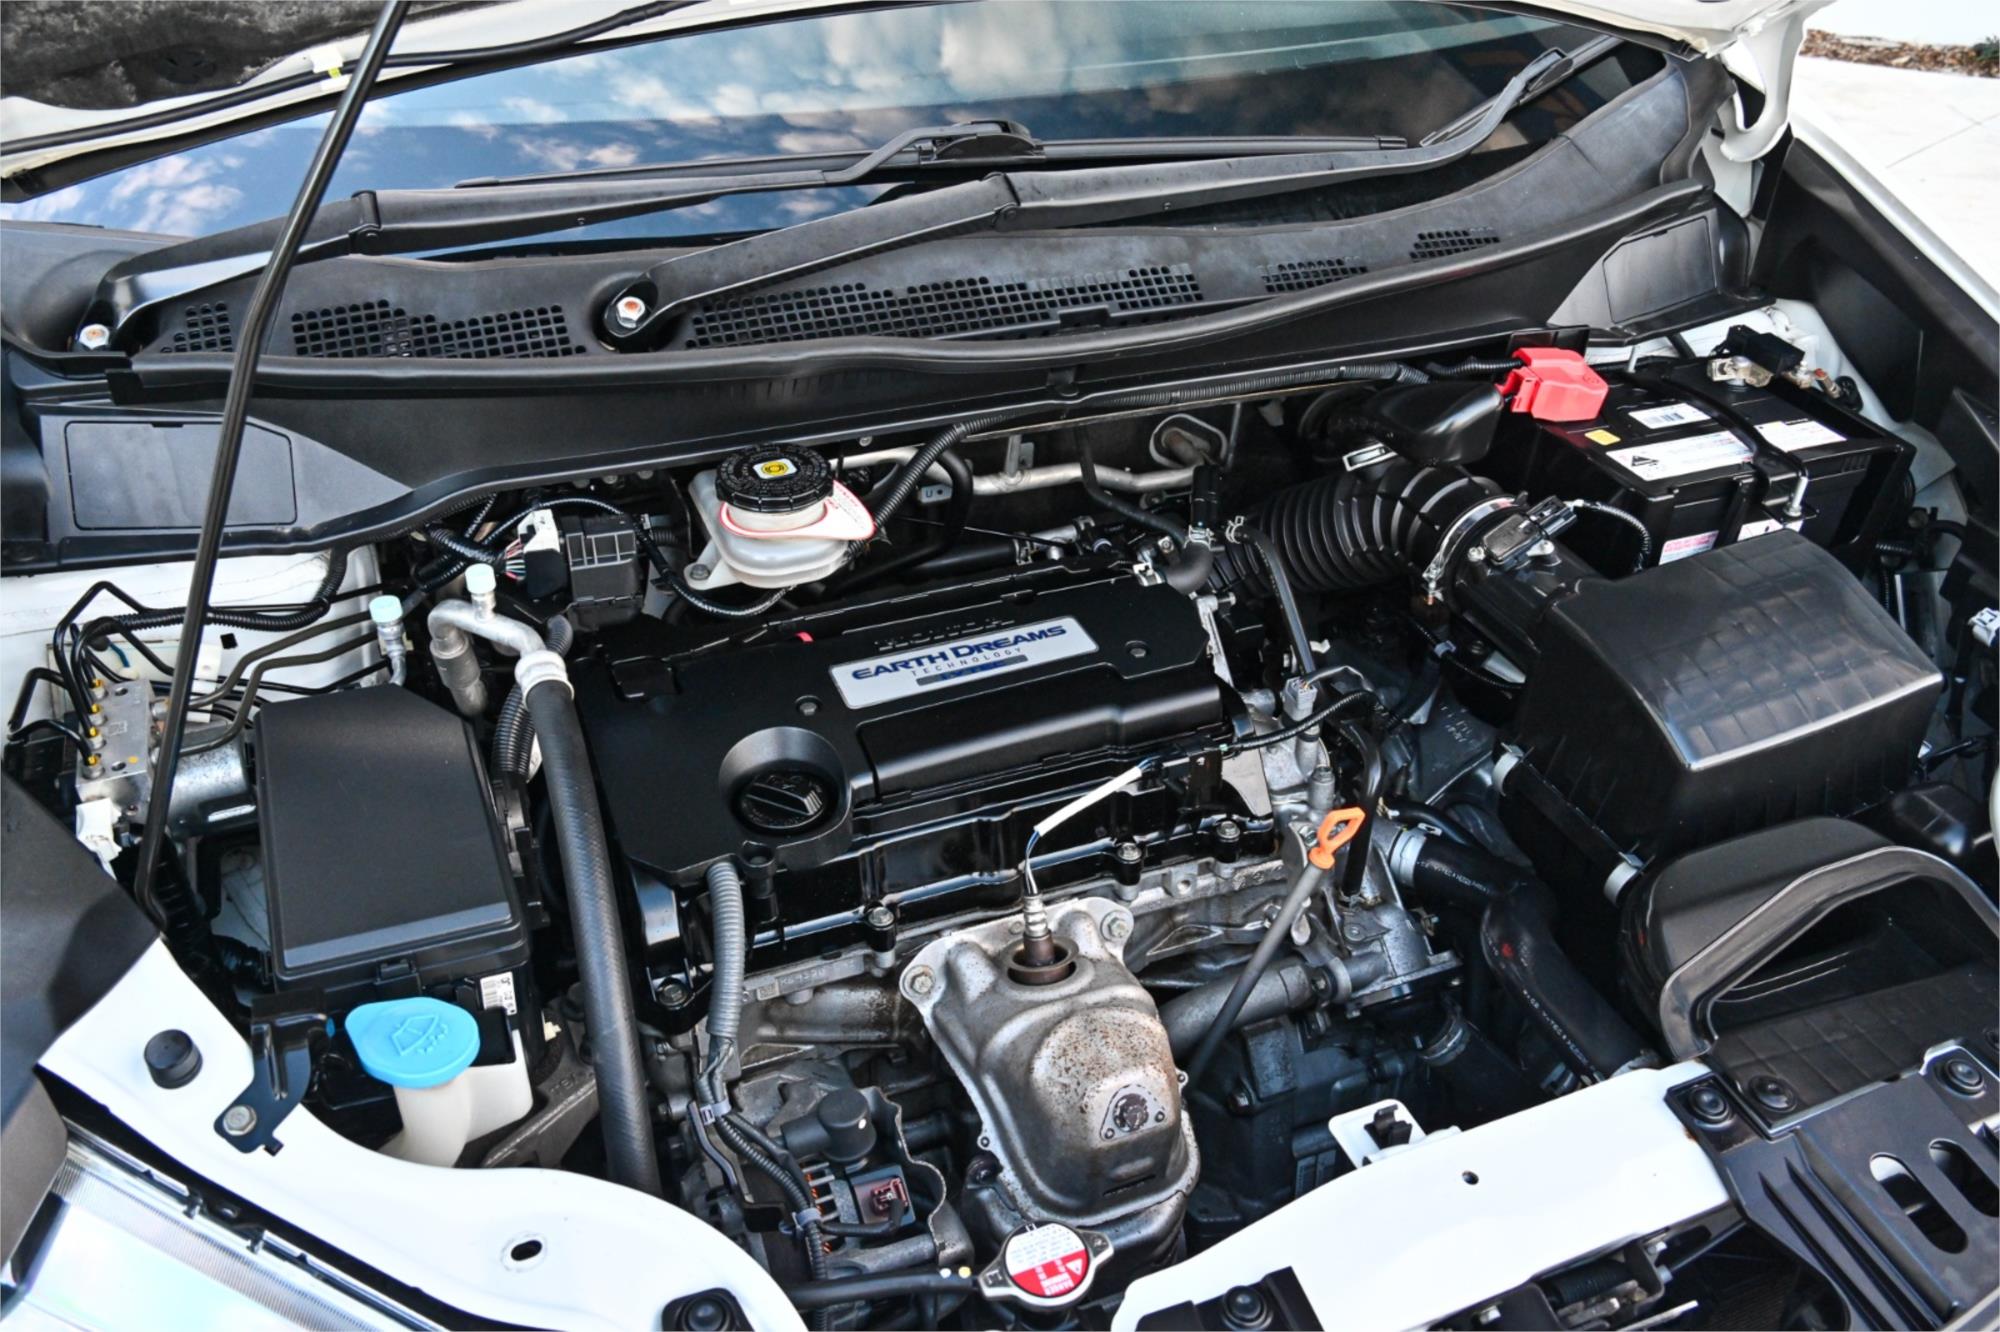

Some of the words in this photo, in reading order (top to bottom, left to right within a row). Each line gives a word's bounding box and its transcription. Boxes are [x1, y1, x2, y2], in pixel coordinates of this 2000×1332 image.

[851, 650, 950, 680] EARTH
[949, 624, 1067, 659] DREAMS
[911, 647, 1023, 677] TECHNOLOGY
